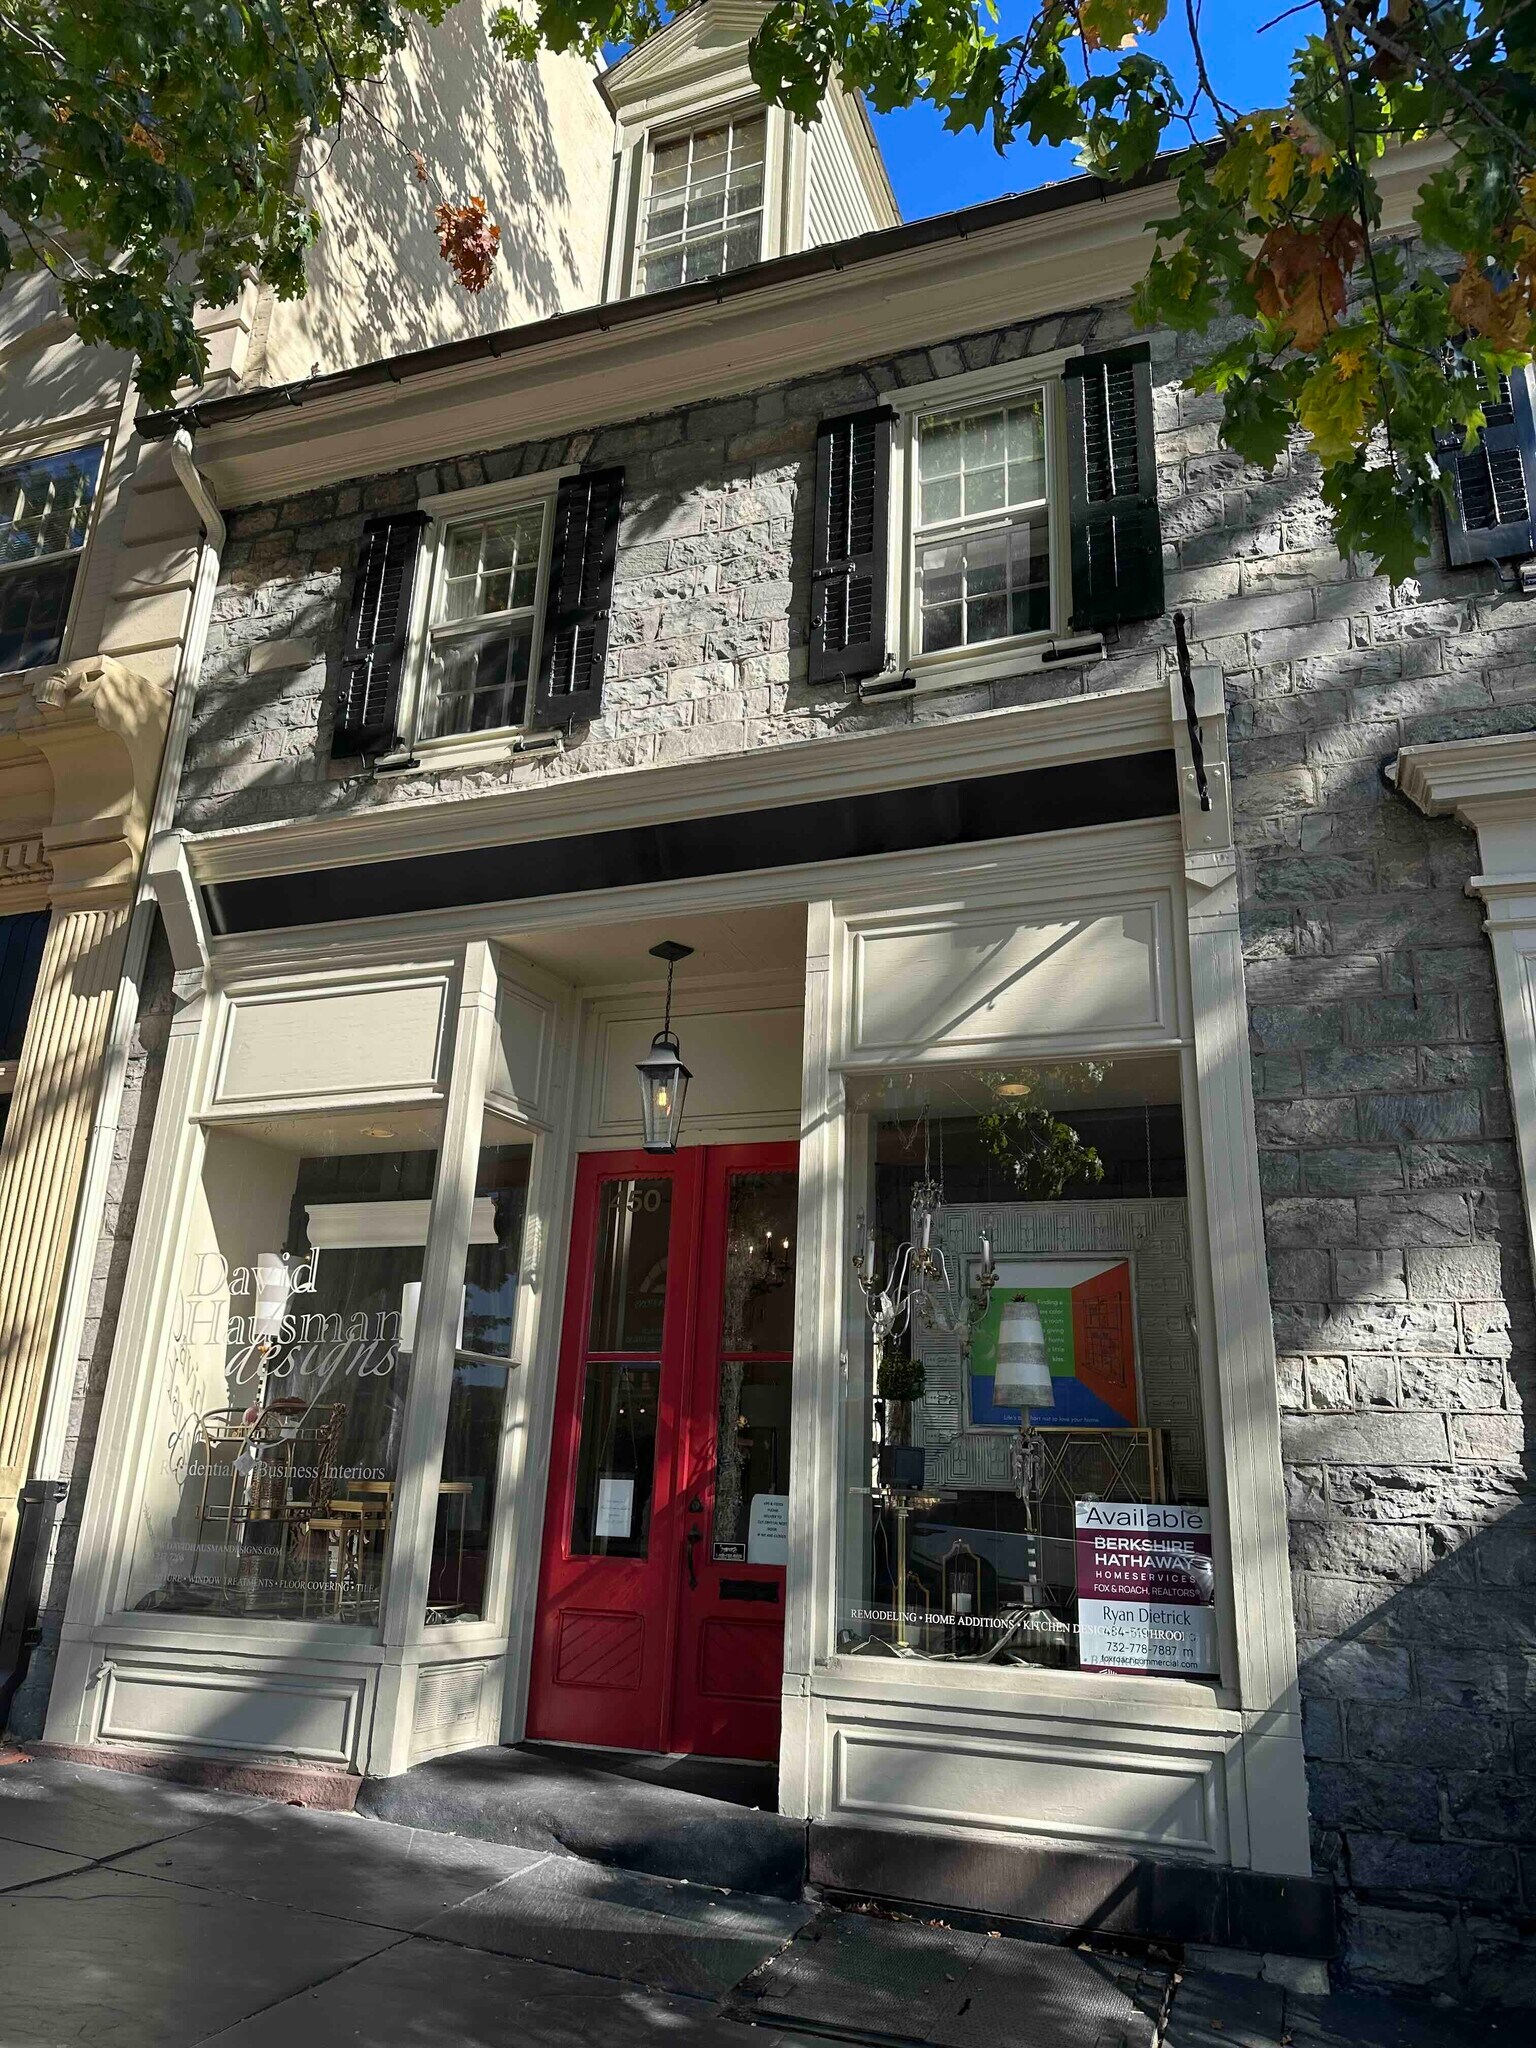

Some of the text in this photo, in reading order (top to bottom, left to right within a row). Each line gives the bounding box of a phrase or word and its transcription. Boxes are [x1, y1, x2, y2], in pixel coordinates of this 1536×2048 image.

[609, 1189, 661, 1213] 450
[187, 1246, 320, 1297] David
[179, 1299, 404, 1346] Hausman
[225, 1334, 402, 1418] designs
[160, 1460, 234, 1478] Rdential
[260, 1461, 318, 1479] Business
[324, 1462, 386, 1480] Interiors
[1086, 1507, 1203, 1529] Available
[1094, 1536, 1195, 1553] BERKSHIRE
[1095, 1553, 1193, 1570] HATHAWAY
[188, 1574, 220, 1585] WINDOW
[223, 1576, 274, 1588] TREATMENTS
[279, 1580, 306, 1590] FLOOR
[307, 1581, 350, 1592] COVERING
[1096, 1571, 1196, 1583] HOMESERVICES
[1094, 1584, 1109, 1593] FOX
[1111, 1585, 1117, 1593] &
[1118, 1585, 1150, 1595] ROACH,
[851, 1609, 917, 1623] REMODELING
[925, 1613, 955, 1625] HOME
[958, 1615, 1015, 1629] ADDITIONS
[1023, 1621, 1070, 1633] KITCHEN
[1103, 1606, 1191, 1625] Ryan Dietrick
[1107, 1642, 1194, 1657] 732-778-7887 m
[1101, 1654, 1198, 1669] foxroachcommercial.com
